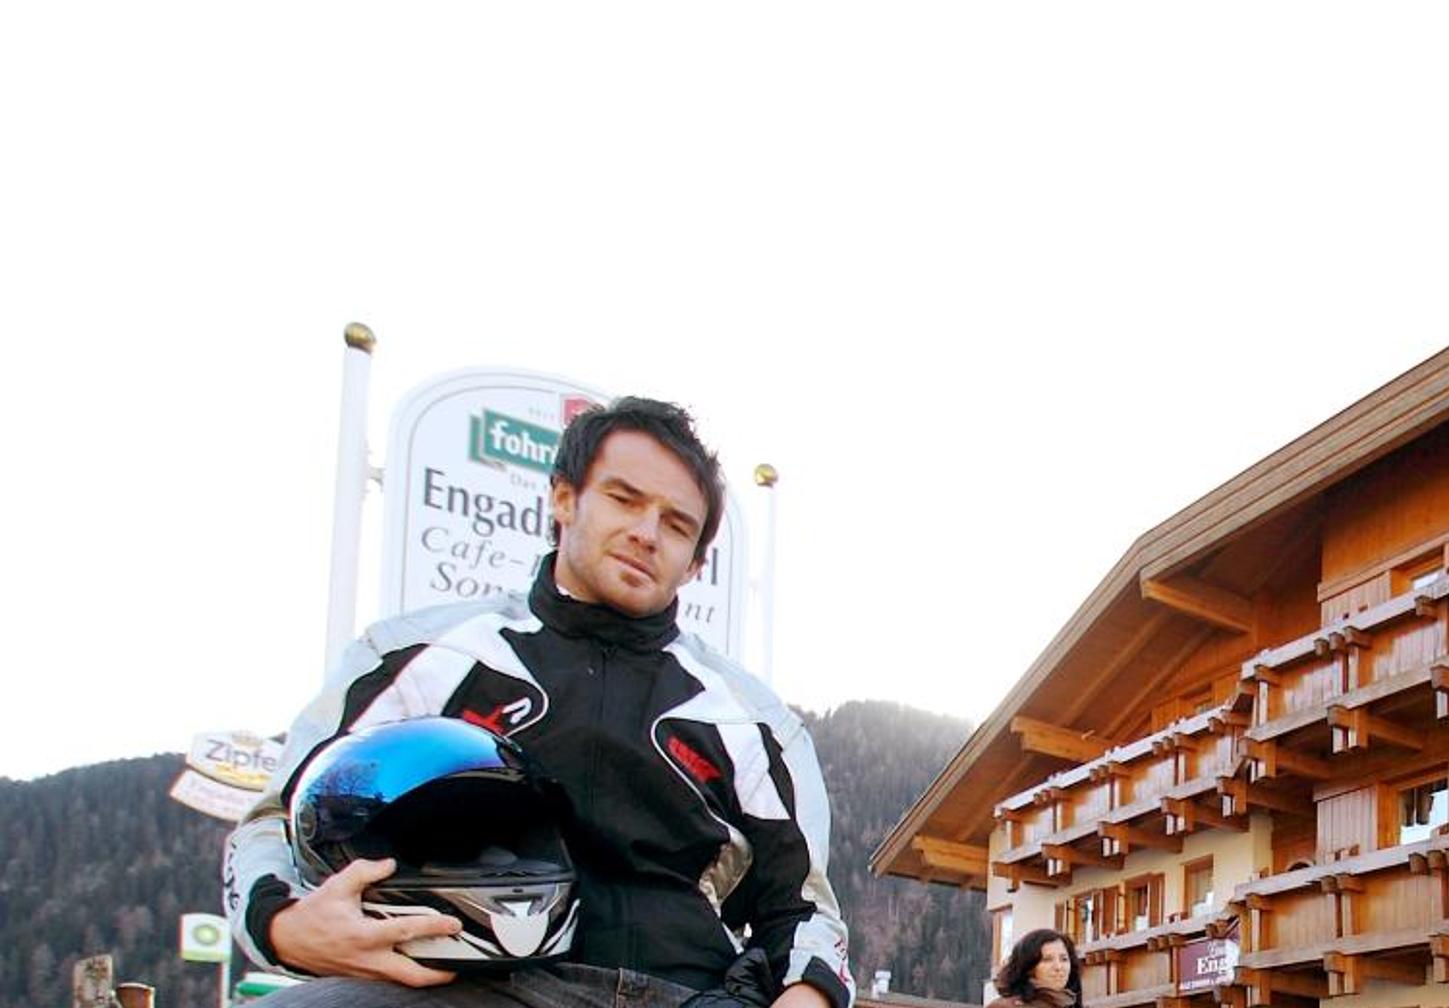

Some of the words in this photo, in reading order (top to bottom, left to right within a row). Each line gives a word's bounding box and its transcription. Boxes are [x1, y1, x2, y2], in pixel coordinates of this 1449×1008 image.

[490, 421, 558, 465] fohr
[423, 466, 553, 538] Engad
[205, 738, 277, 773] Zipfe
